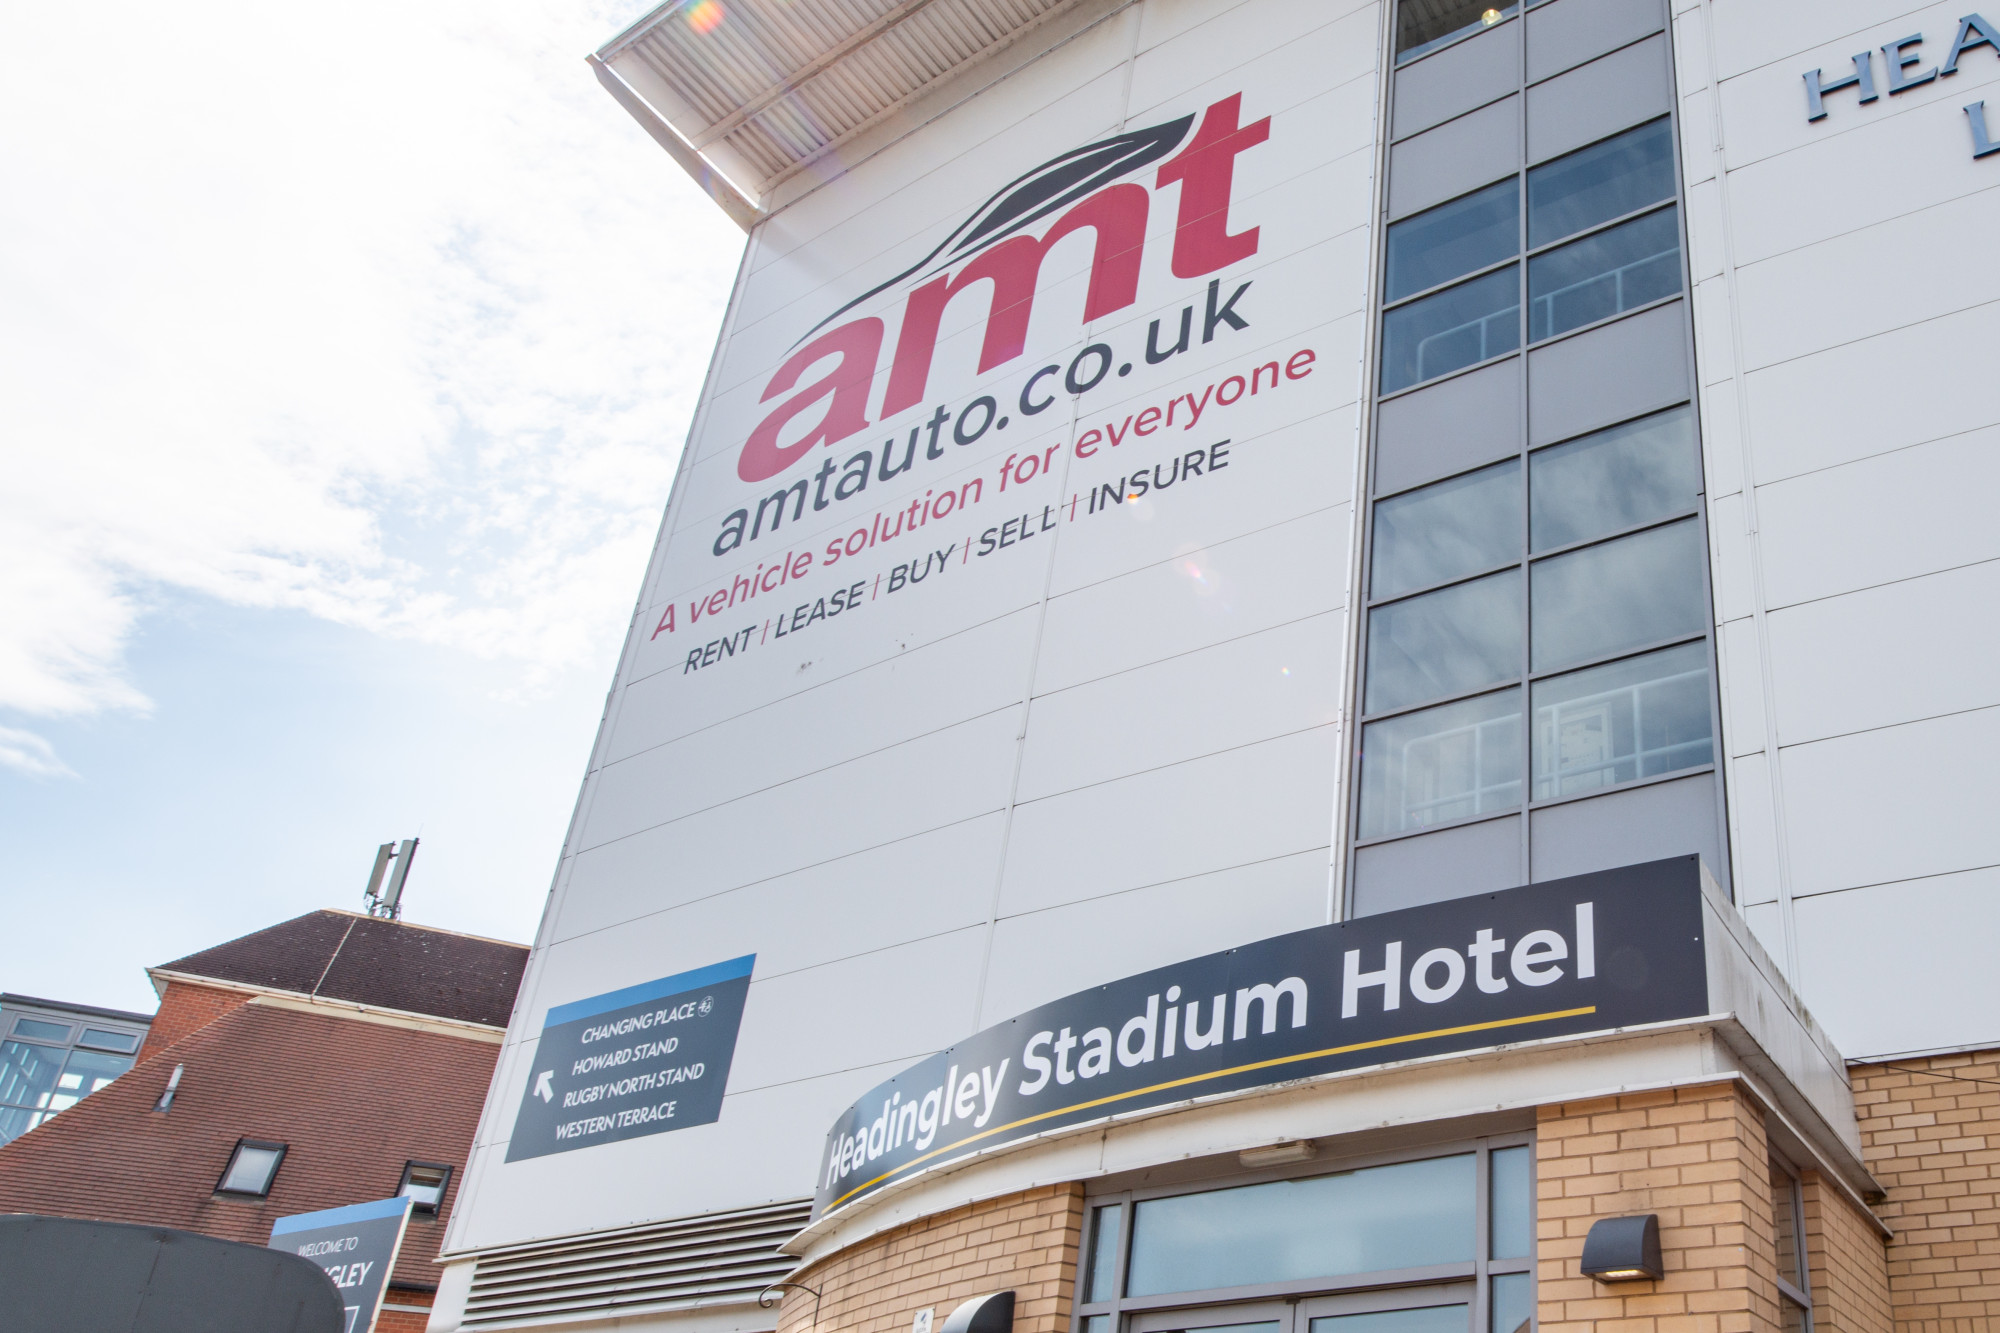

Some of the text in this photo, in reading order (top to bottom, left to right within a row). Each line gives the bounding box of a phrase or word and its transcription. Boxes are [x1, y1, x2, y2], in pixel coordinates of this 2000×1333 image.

[738, 91, 1272, 483] amt
[712, 278, 1254, 557] amtauto.co.uk
[650, 349, 1316, 641] A vehicle solution for everyone
[684, 625, 758, 675] RENT
[774, 580, 866, 639] LEASE
[887, 543, 956, 594] BUY
[977, 505, 1057, 557] SELL
[1088, 438, 1232, 515] INSURE
[581, 1001, 697, 1044] CHANGING PLACE
[572, 1037, 679, 1076] HOWARD STAND
[825, 902, 1596, 1190] Headingley Stadium Hotel
[562, 1063, 705, 1108] RUGBY NORTH STAND
[556, 1101, 677, 1140] WESTERN TERRACE
[298, 1236, 359, 1257] WELCOME TO
[324, 1261, 374, 1288] GLEY
